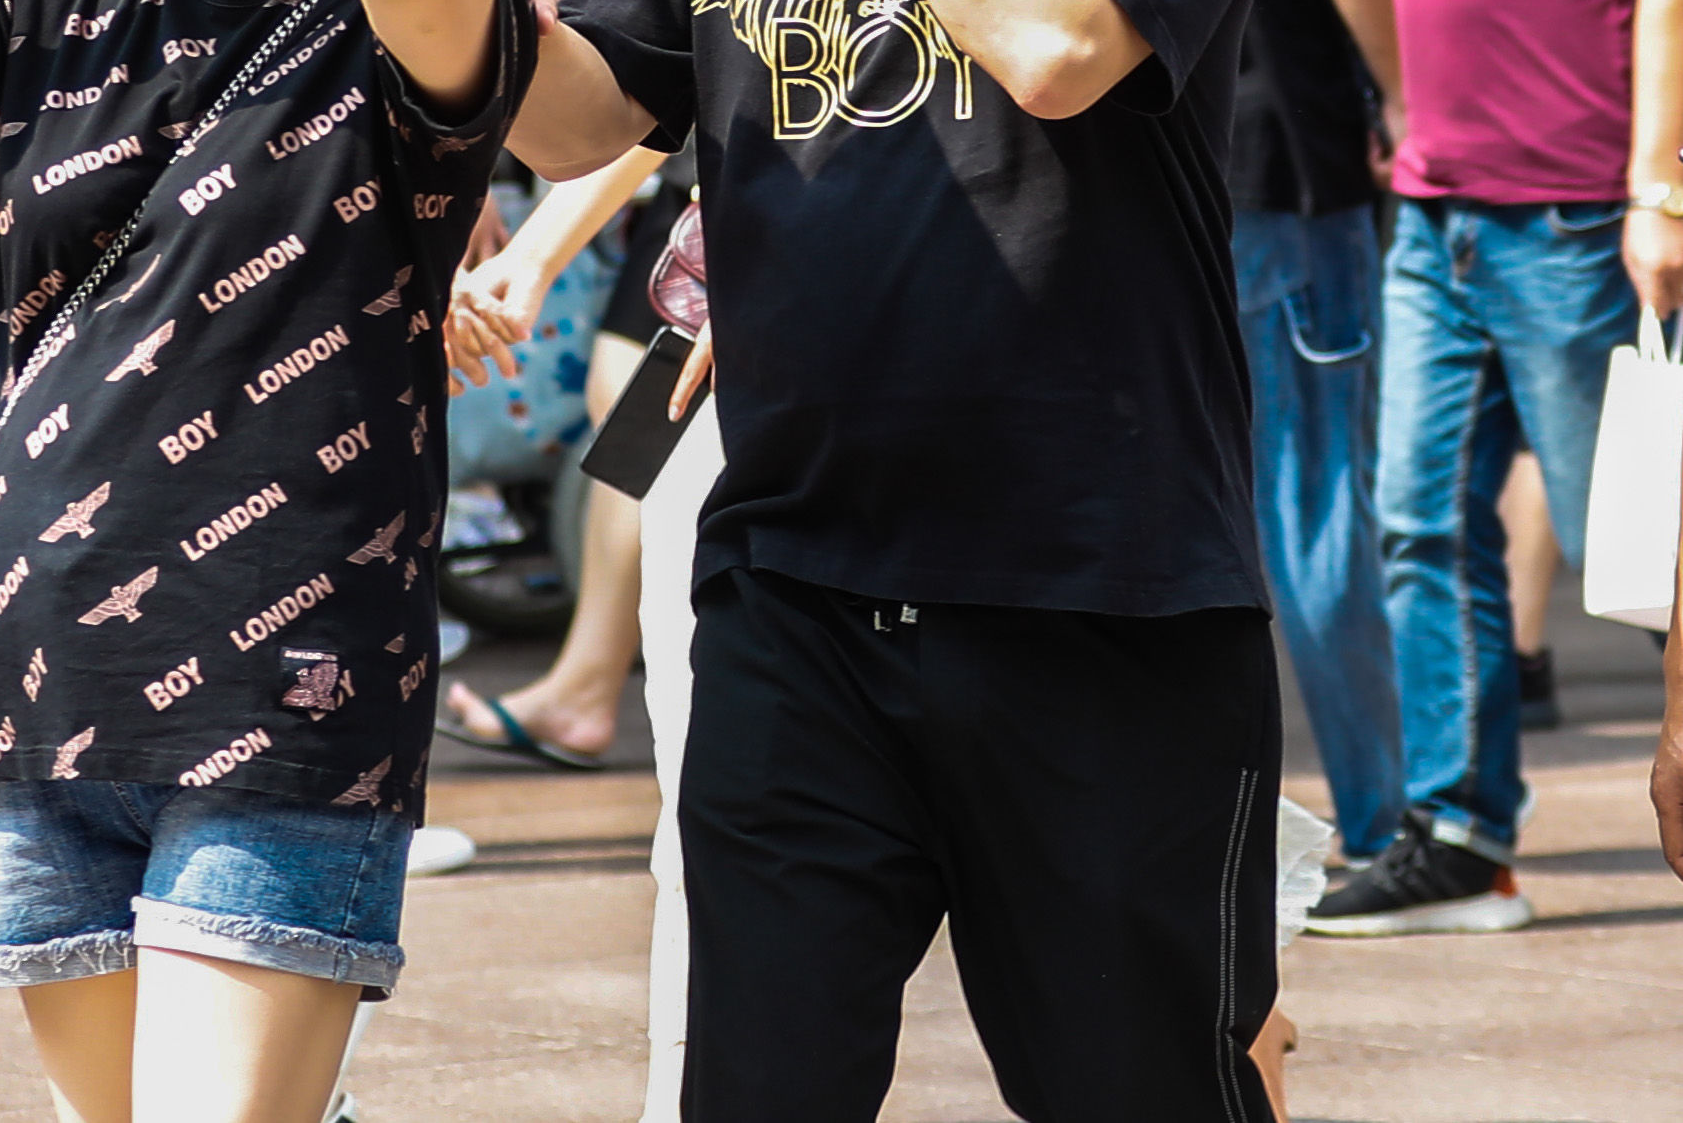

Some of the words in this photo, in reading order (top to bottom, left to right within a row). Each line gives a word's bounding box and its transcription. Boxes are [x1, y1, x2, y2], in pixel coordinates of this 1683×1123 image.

[161, 36, 218, 65] BOY
[246, 18, 348, 97] LONDON
[264, 85, 367, 161] LONDON
[31, 134, 144, 196] LONDON
[178, 162, 238, 217] BOY
[197, 233, 307, 315] LONDON
[243, 324, 352, 405] LONDON
[24, 403, 70, 460] BOY
[157, 410, 220, 465] BOY
[316, 420, 372, 475] BOY
[179, 481, 289, 562] LONDON
[229, 572, 335, 653] LONDON
[143, 656, 205, 712] BOY
[399, 652, 428, 703] BOY
[177, 727, 273, 788] ONDON
